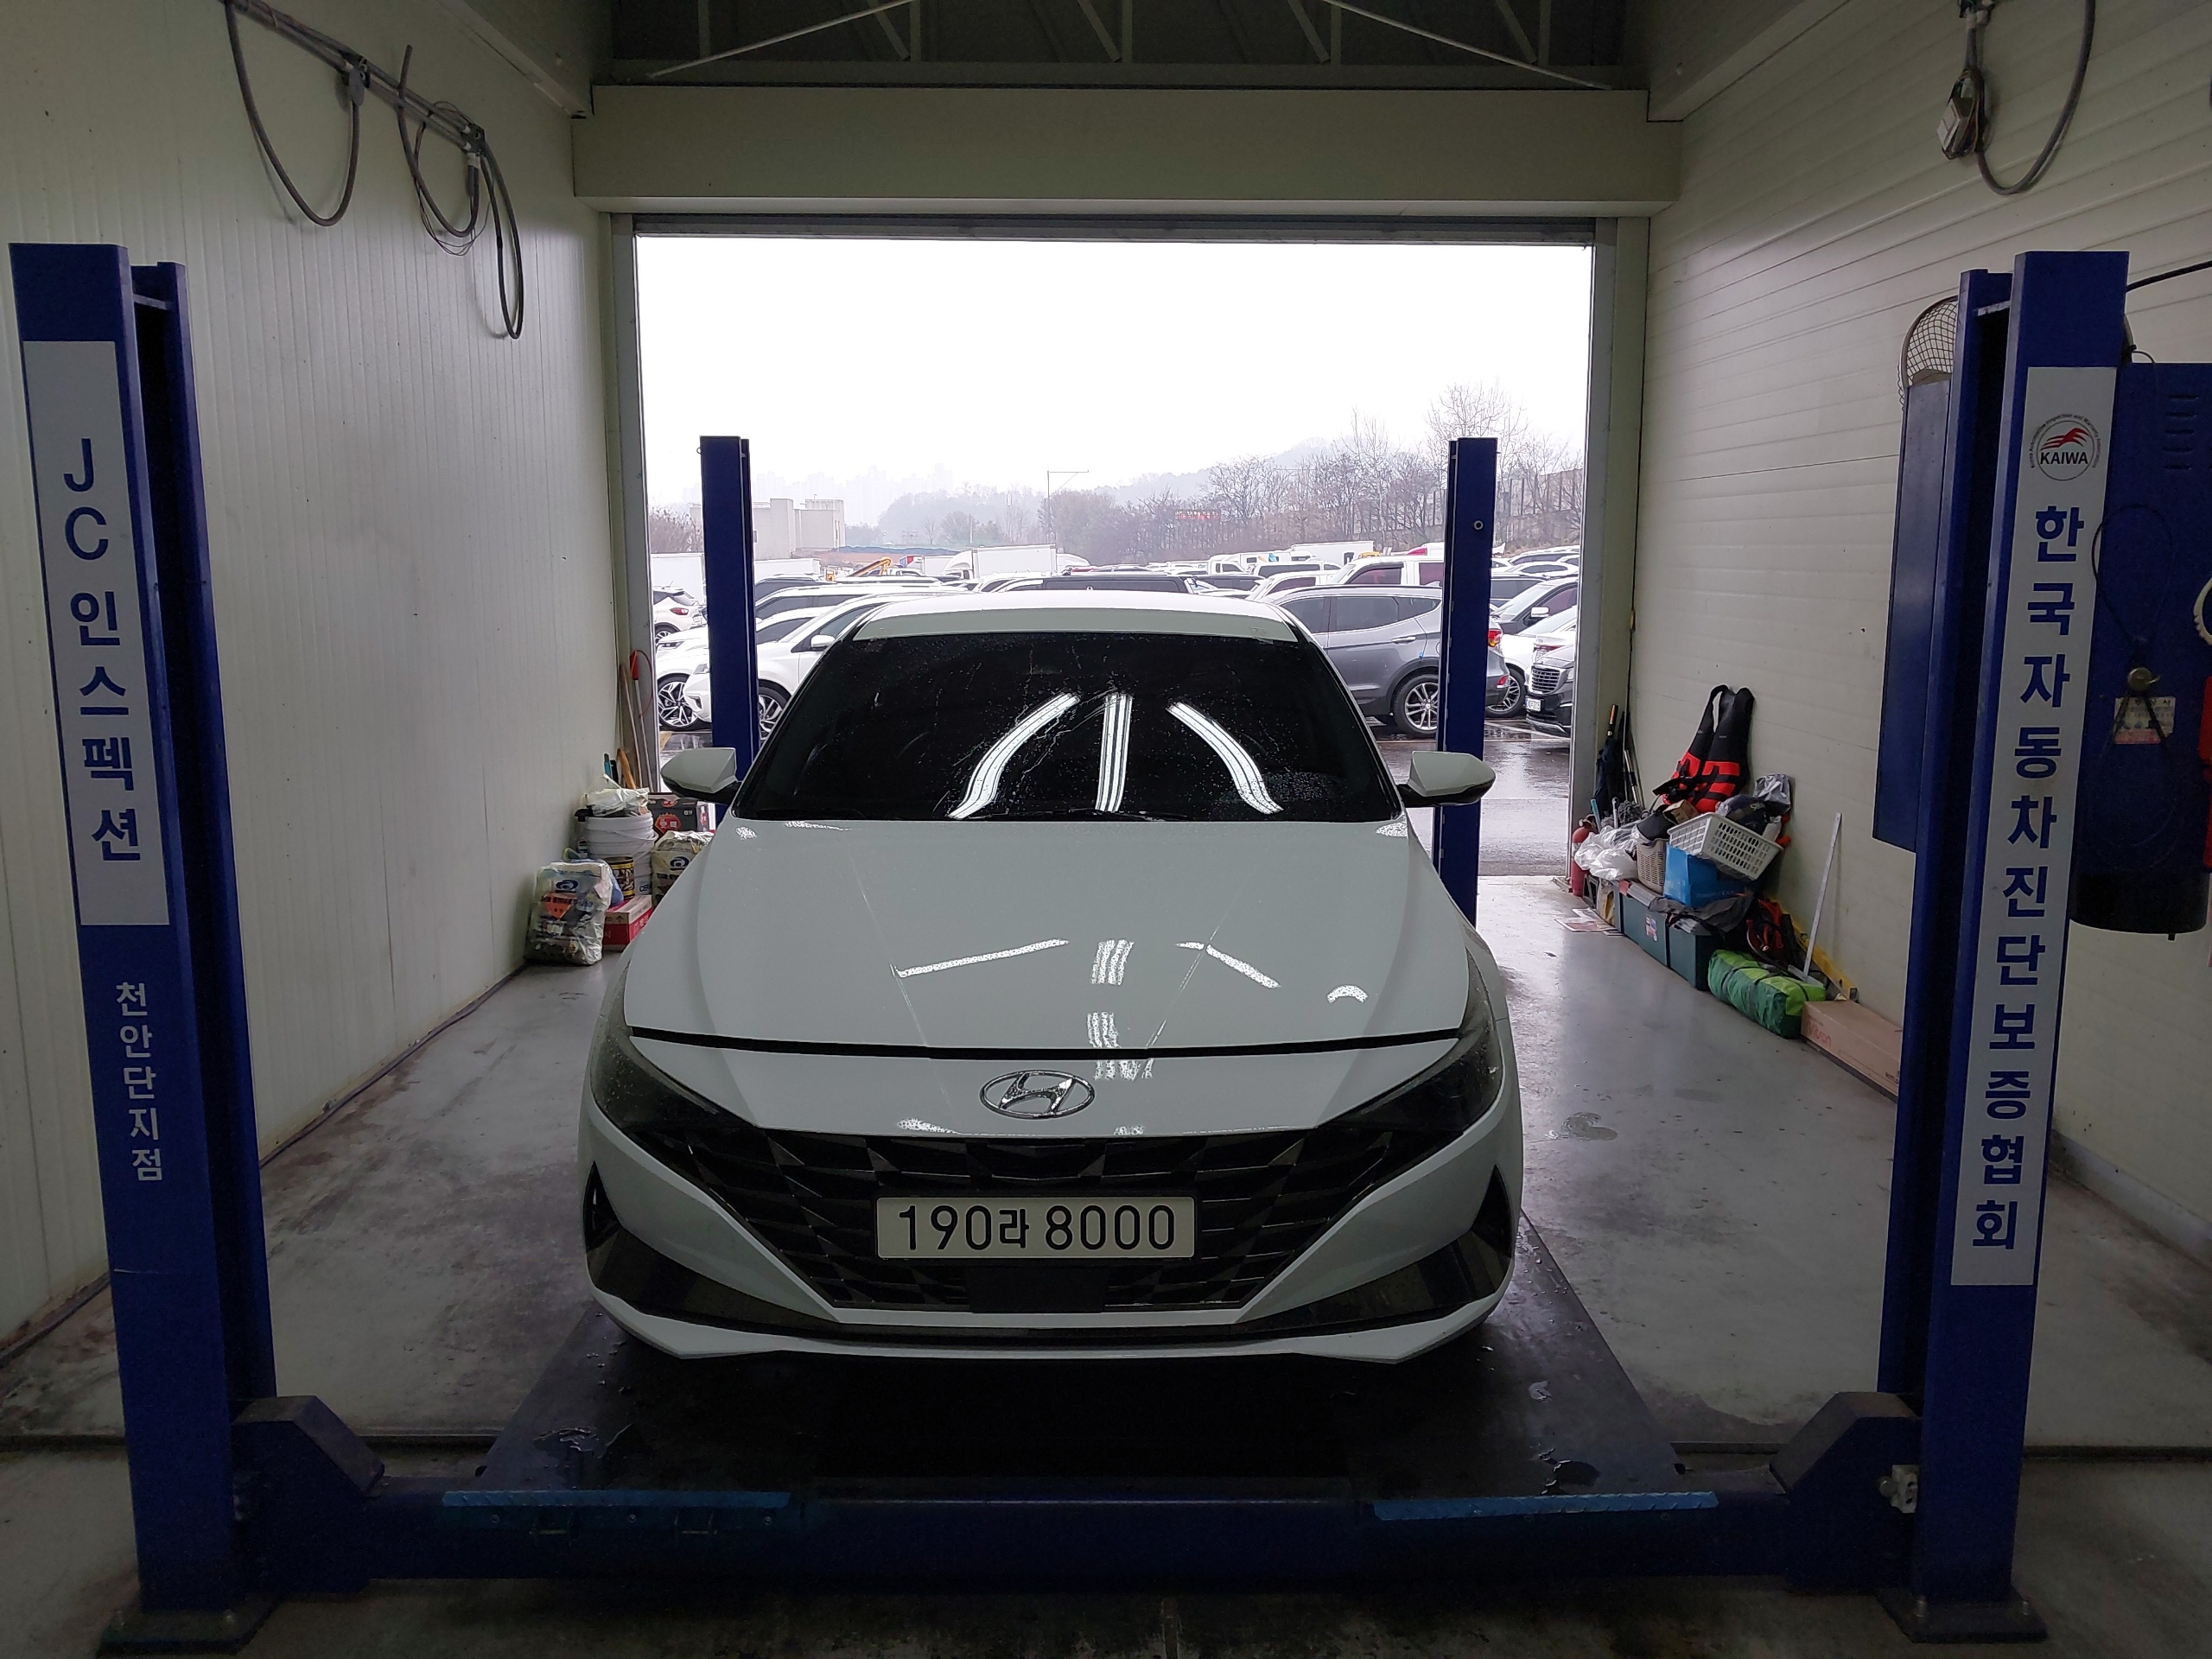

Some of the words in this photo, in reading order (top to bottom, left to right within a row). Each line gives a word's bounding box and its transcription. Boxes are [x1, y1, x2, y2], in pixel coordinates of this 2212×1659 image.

[2040, 452, 2088, 464] KAIWA
[1972, 505, 2085, 1250] 한국자동차진단보증협회
[116, 982, 162, 1181] 천안단지점
[899, 1205, 1030, 1250] 190라
[1045, 1205, 1175, 1250] 8000
